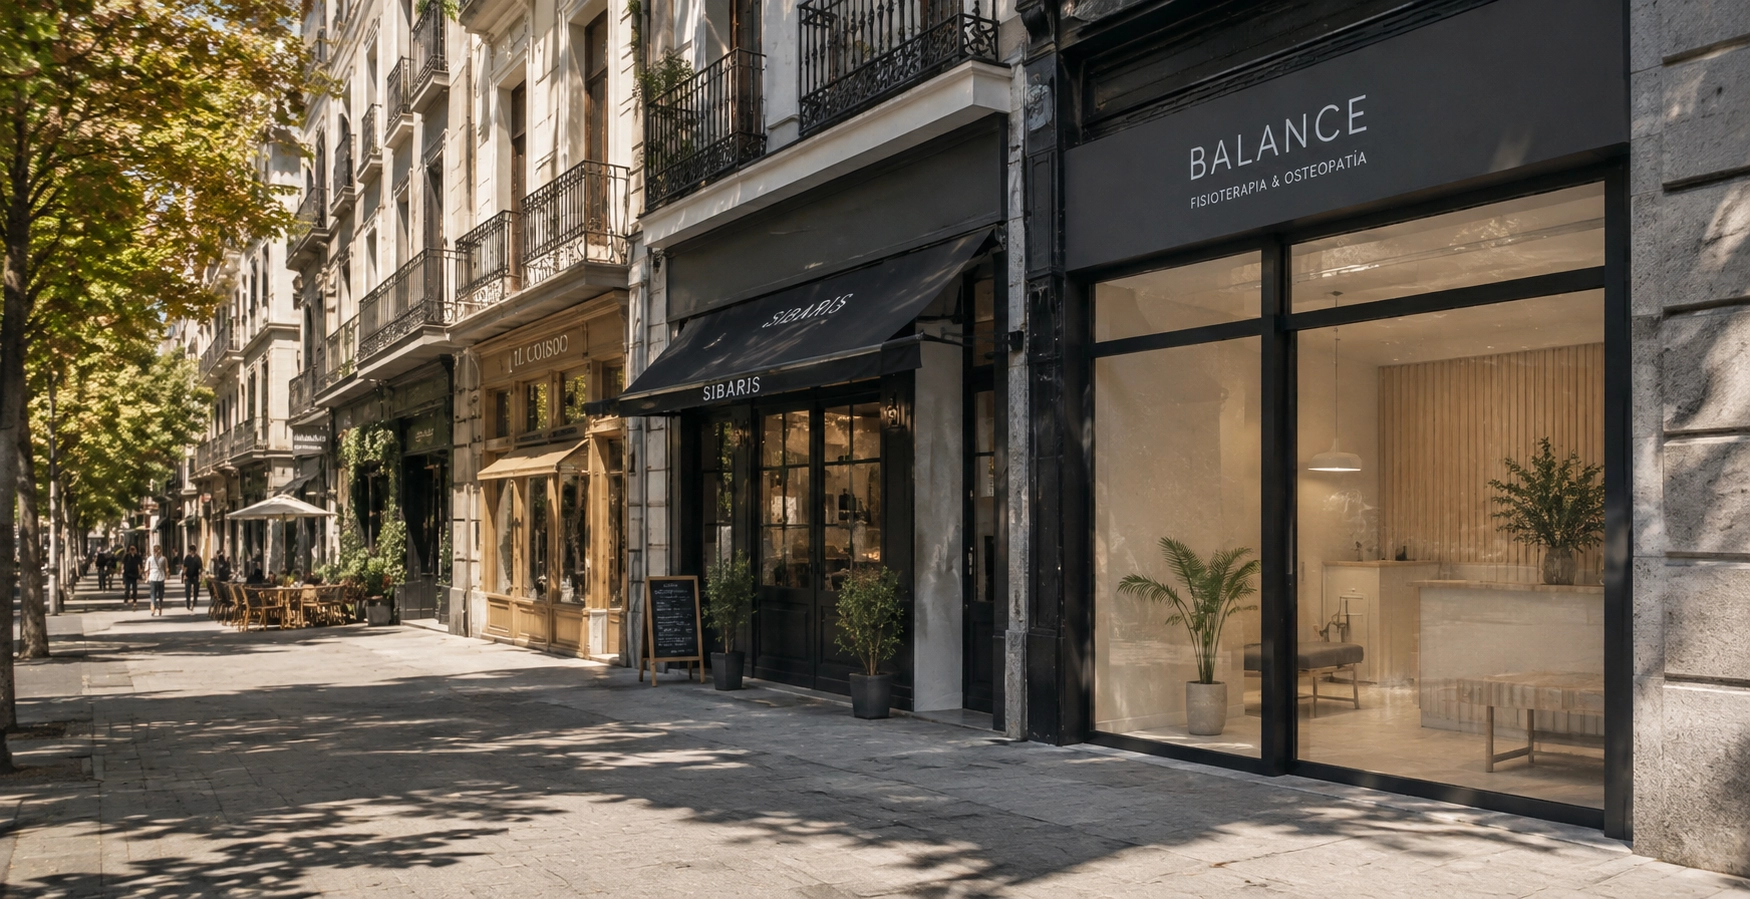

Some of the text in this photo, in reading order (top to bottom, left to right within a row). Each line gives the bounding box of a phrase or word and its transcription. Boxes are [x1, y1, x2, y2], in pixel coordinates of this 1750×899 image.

[1190, 94, 1367, 181] BALANCE
[1190, 149, 1367, 209] FISIOTERAPIA & OSTEOPATÍA
